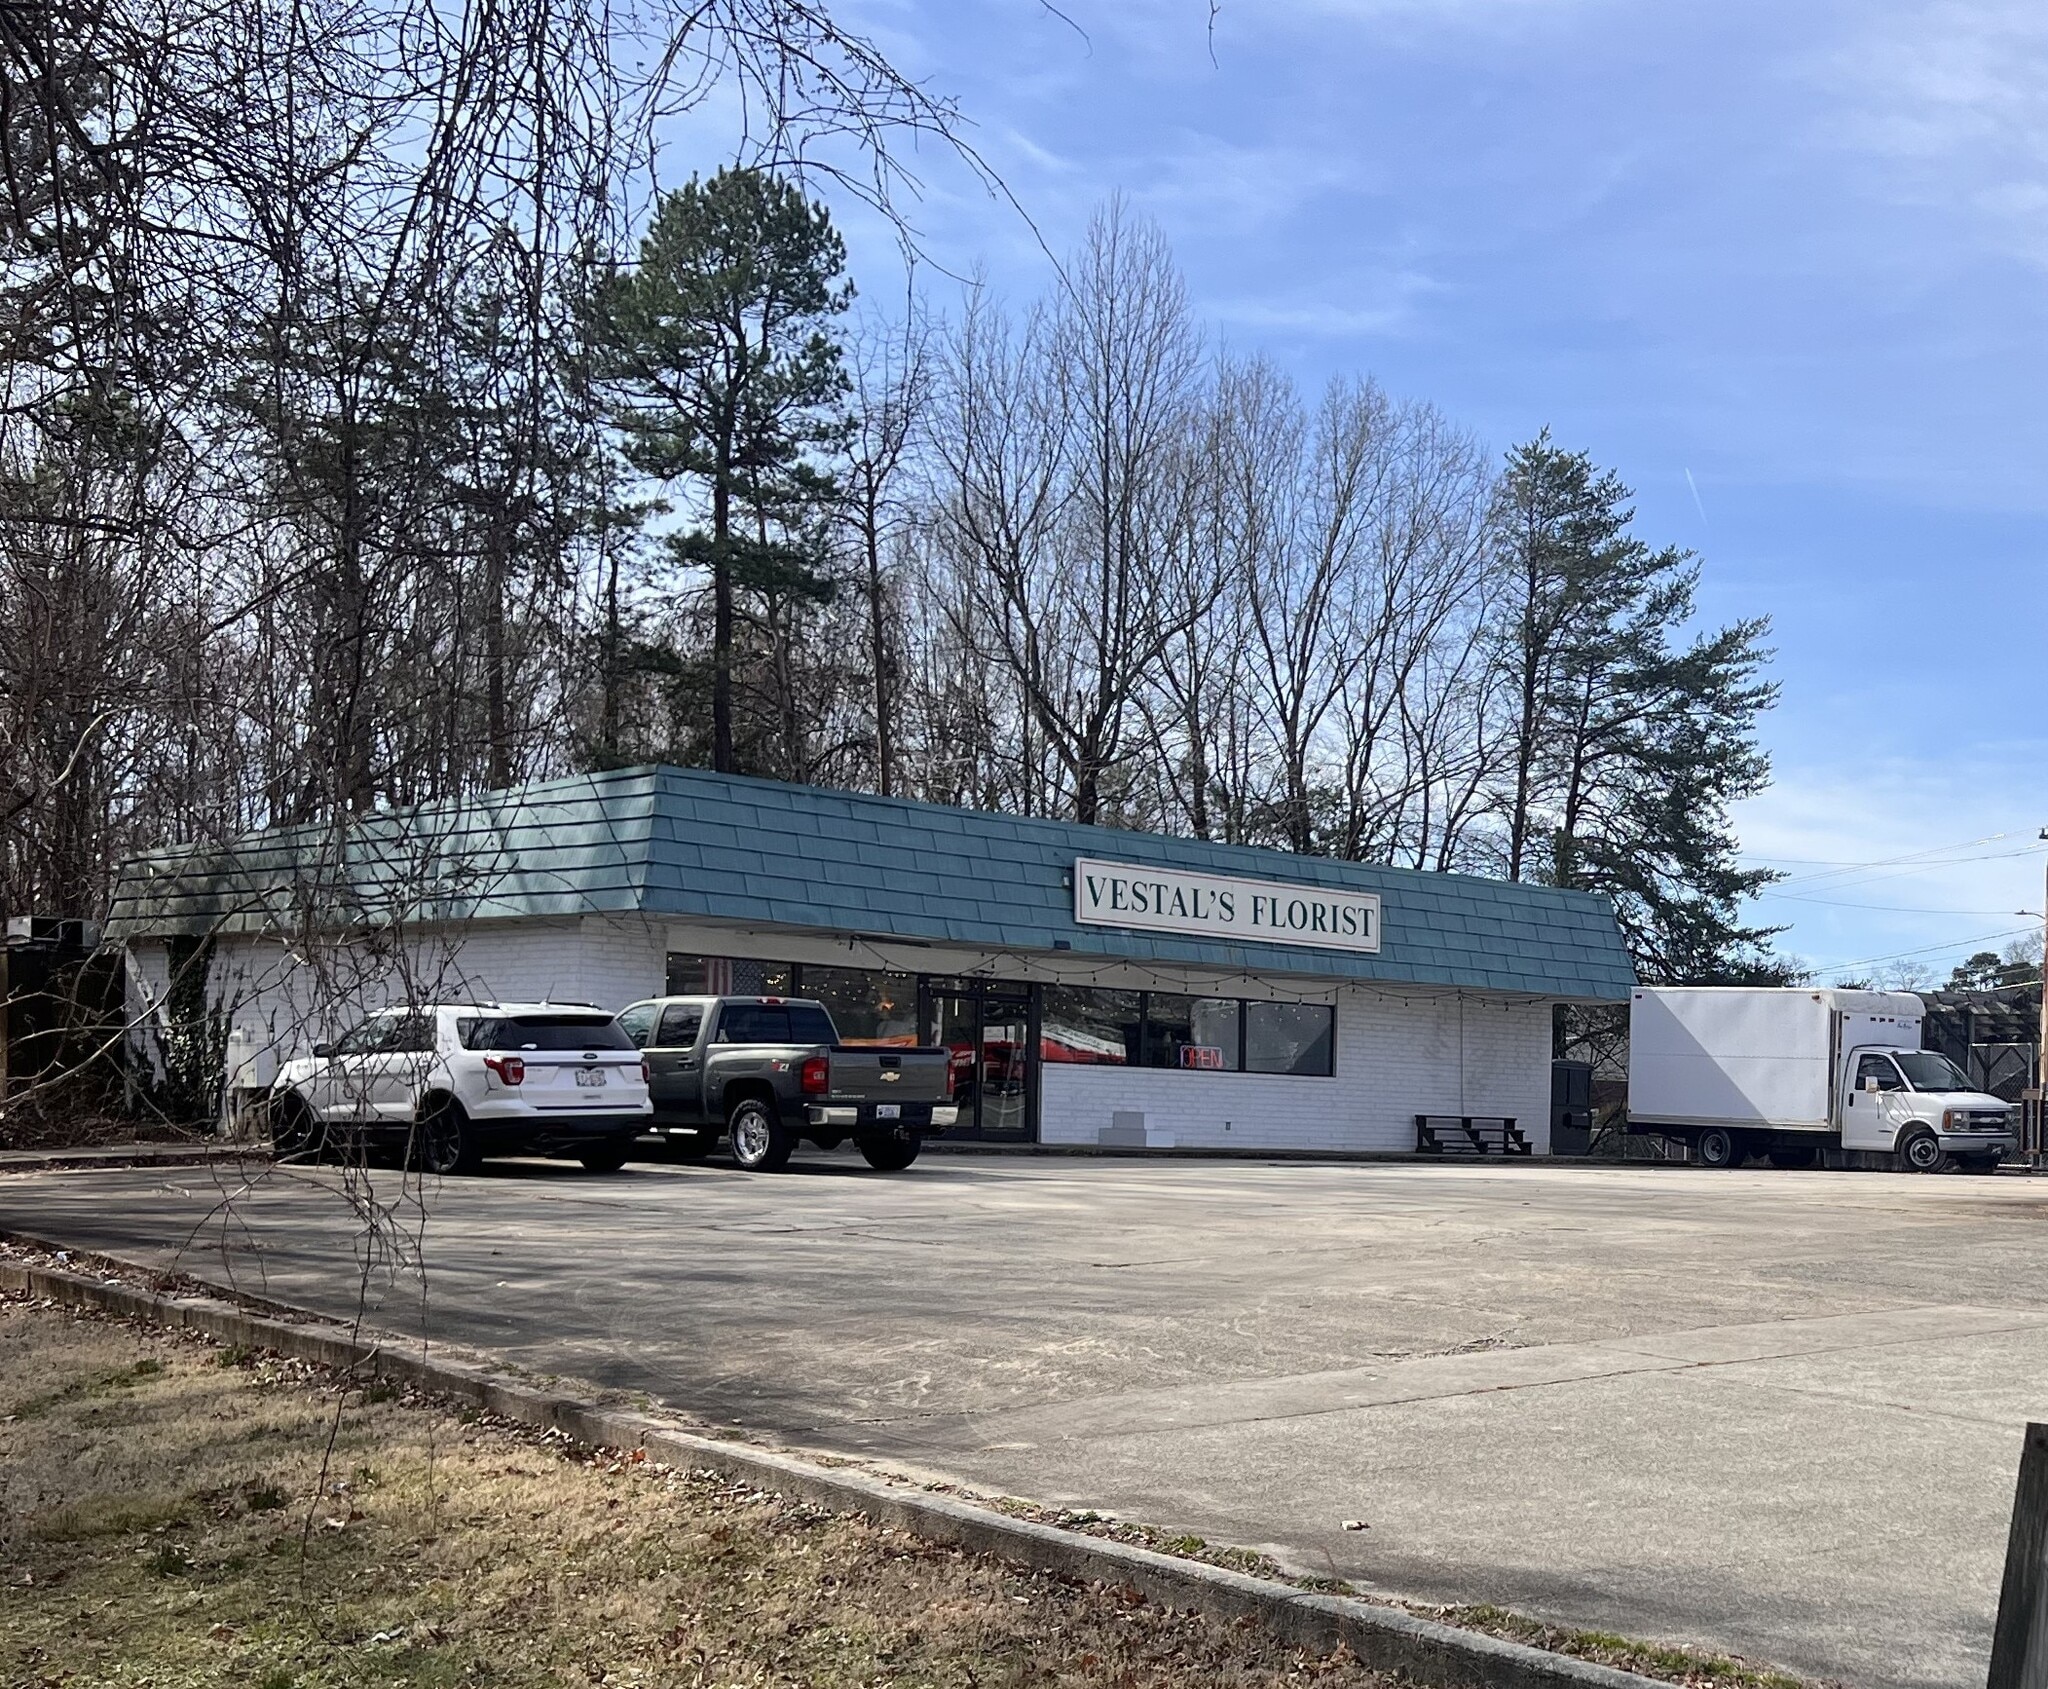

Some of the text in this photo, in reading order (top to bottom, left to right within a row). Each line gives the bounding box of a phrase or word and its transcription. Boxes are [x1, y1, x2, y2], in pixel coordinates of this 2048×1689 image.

[1086, 875, 1375, 937] VESTAL'S FLORIST
[1183, 1047, 1223, 1069] OPEN
